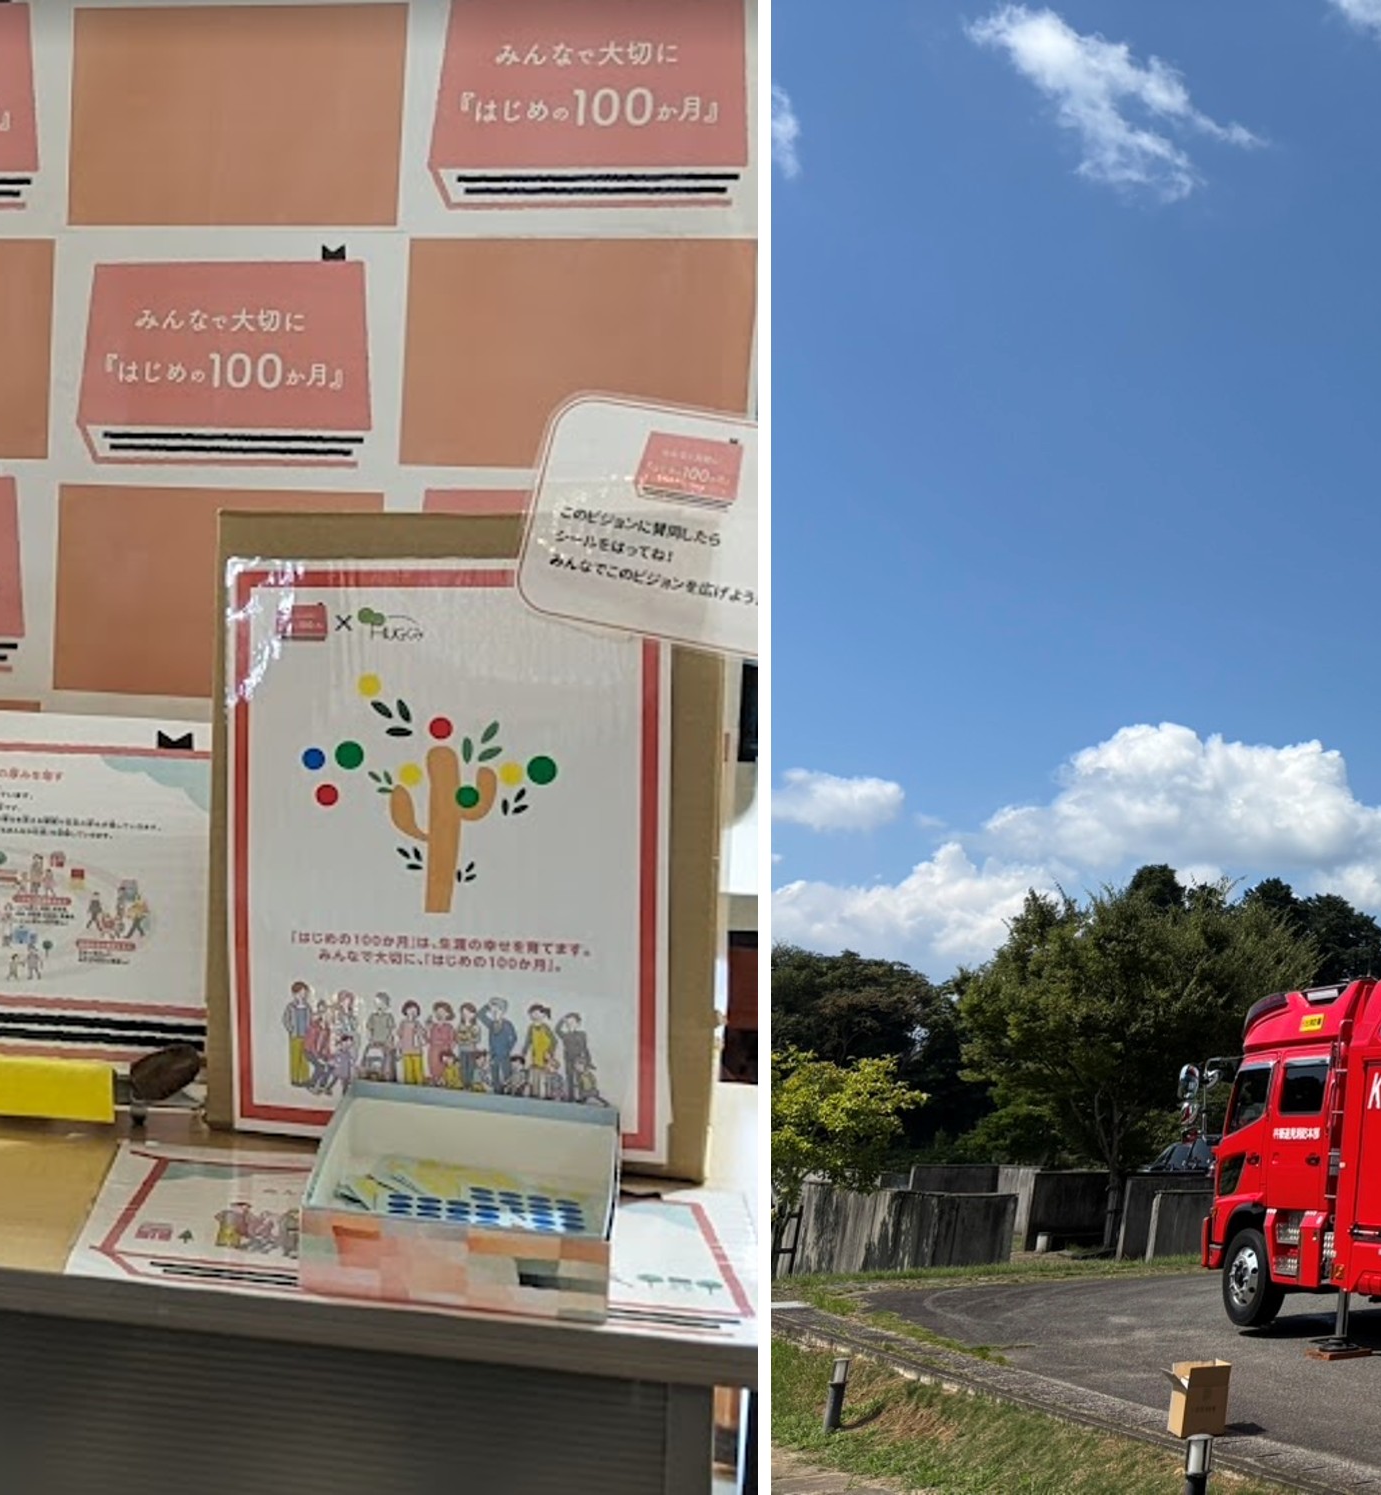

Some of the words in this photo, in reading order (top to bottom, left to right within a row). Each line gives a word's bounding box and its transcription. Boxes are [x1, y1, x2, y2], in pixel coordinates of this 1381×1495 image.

[496, 42, 677, 66] みんなで大切に
[135, 308, 304, 331] みんなで大切に
[560, 506, 721, 547] このビジョンに賛同したら
